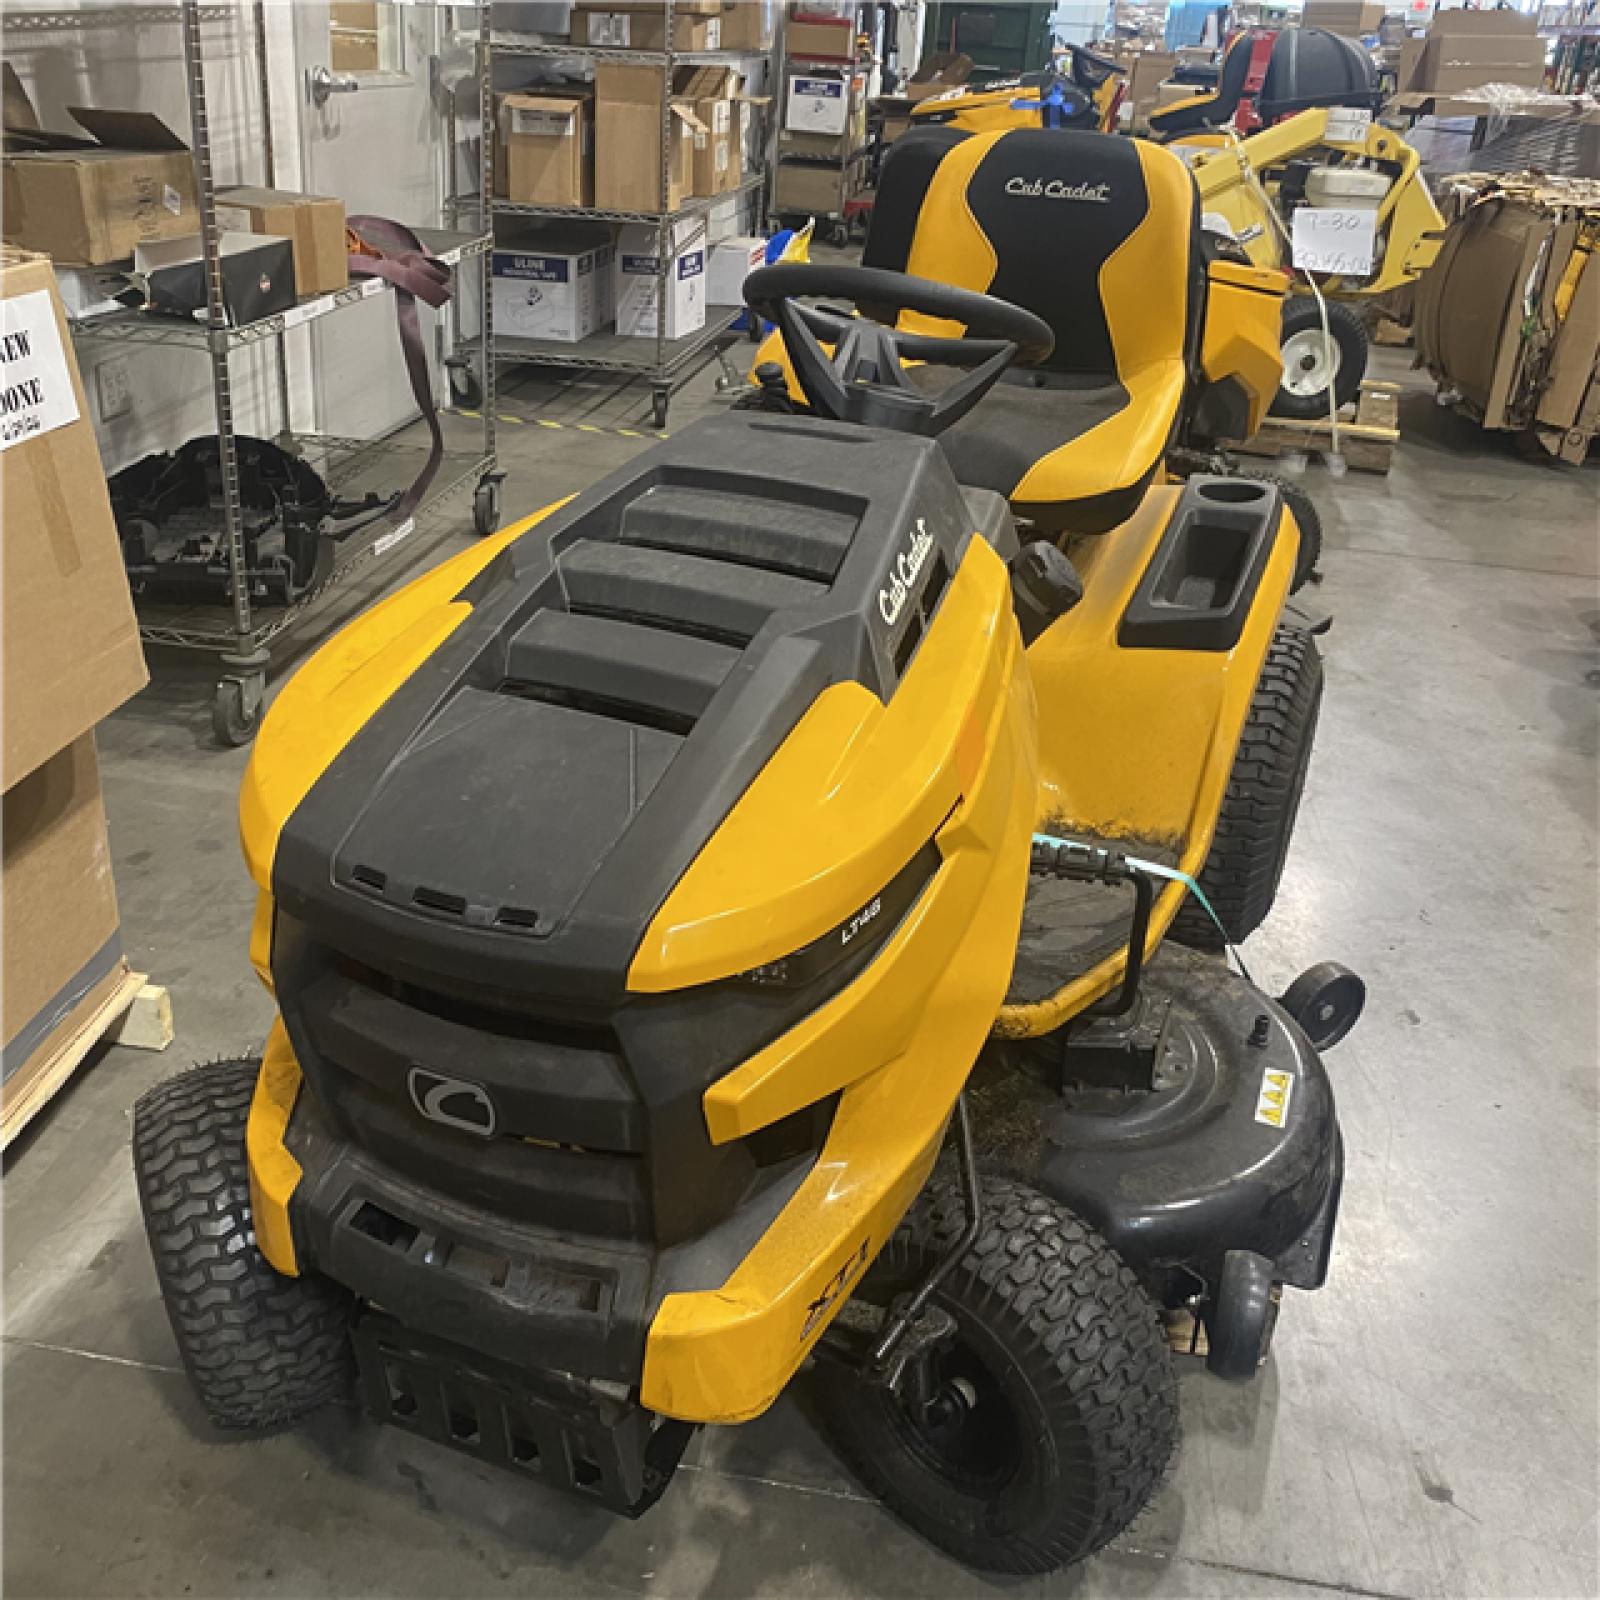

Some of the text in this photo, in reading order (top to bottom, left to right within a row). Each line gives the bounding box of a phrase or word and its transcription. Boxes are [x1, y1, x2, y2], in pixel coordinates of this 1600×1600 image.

[1004, 177, 1111, 203] Cub Cadet
[879, 518, 934, 626] Cub Cadet
